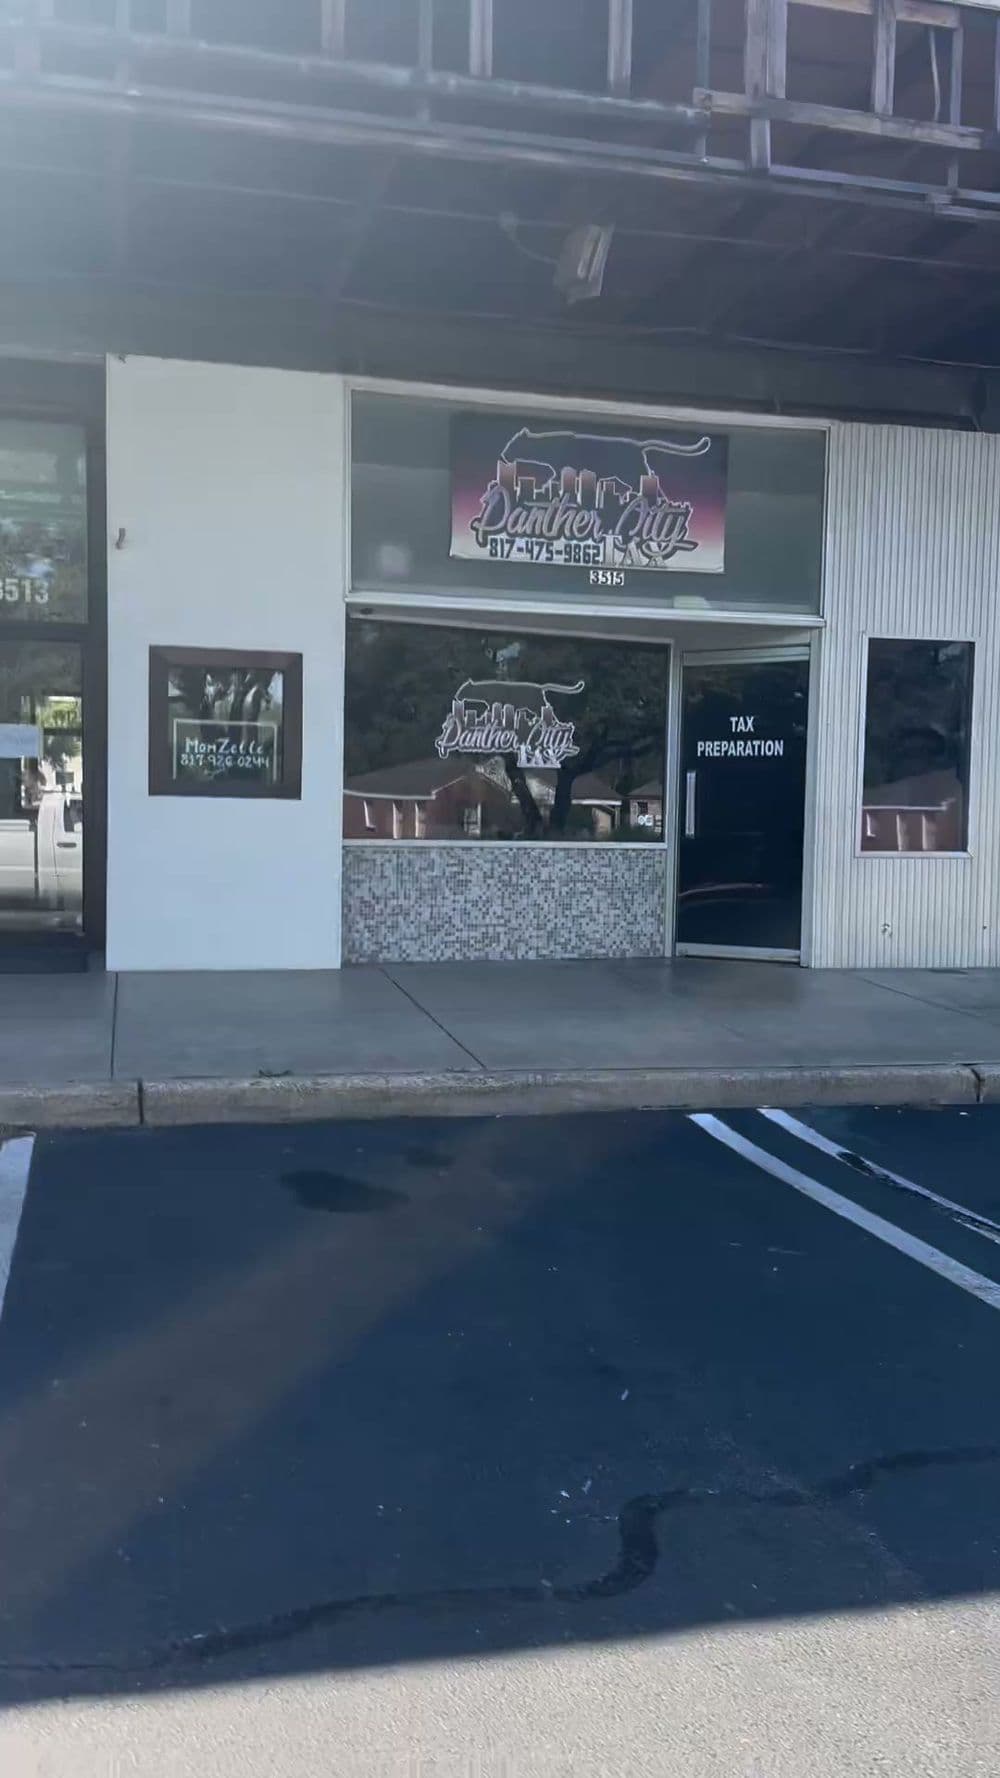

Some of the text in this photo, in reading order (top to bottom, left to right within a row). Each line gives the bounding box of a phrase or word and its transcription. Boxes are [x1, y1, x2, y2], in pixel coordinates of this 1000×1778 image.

[471, 485, 699, 557] Panther City
[489, 540, 602, 565] 817-475-9862
[0, 578, 48, 604] 513
[590, 571, 624, 586] 3515
[729, 716, 755, 732] TAX
[436, 716, 579, 759] Panther City
[697, 740, 784, 757] PREPARATION
